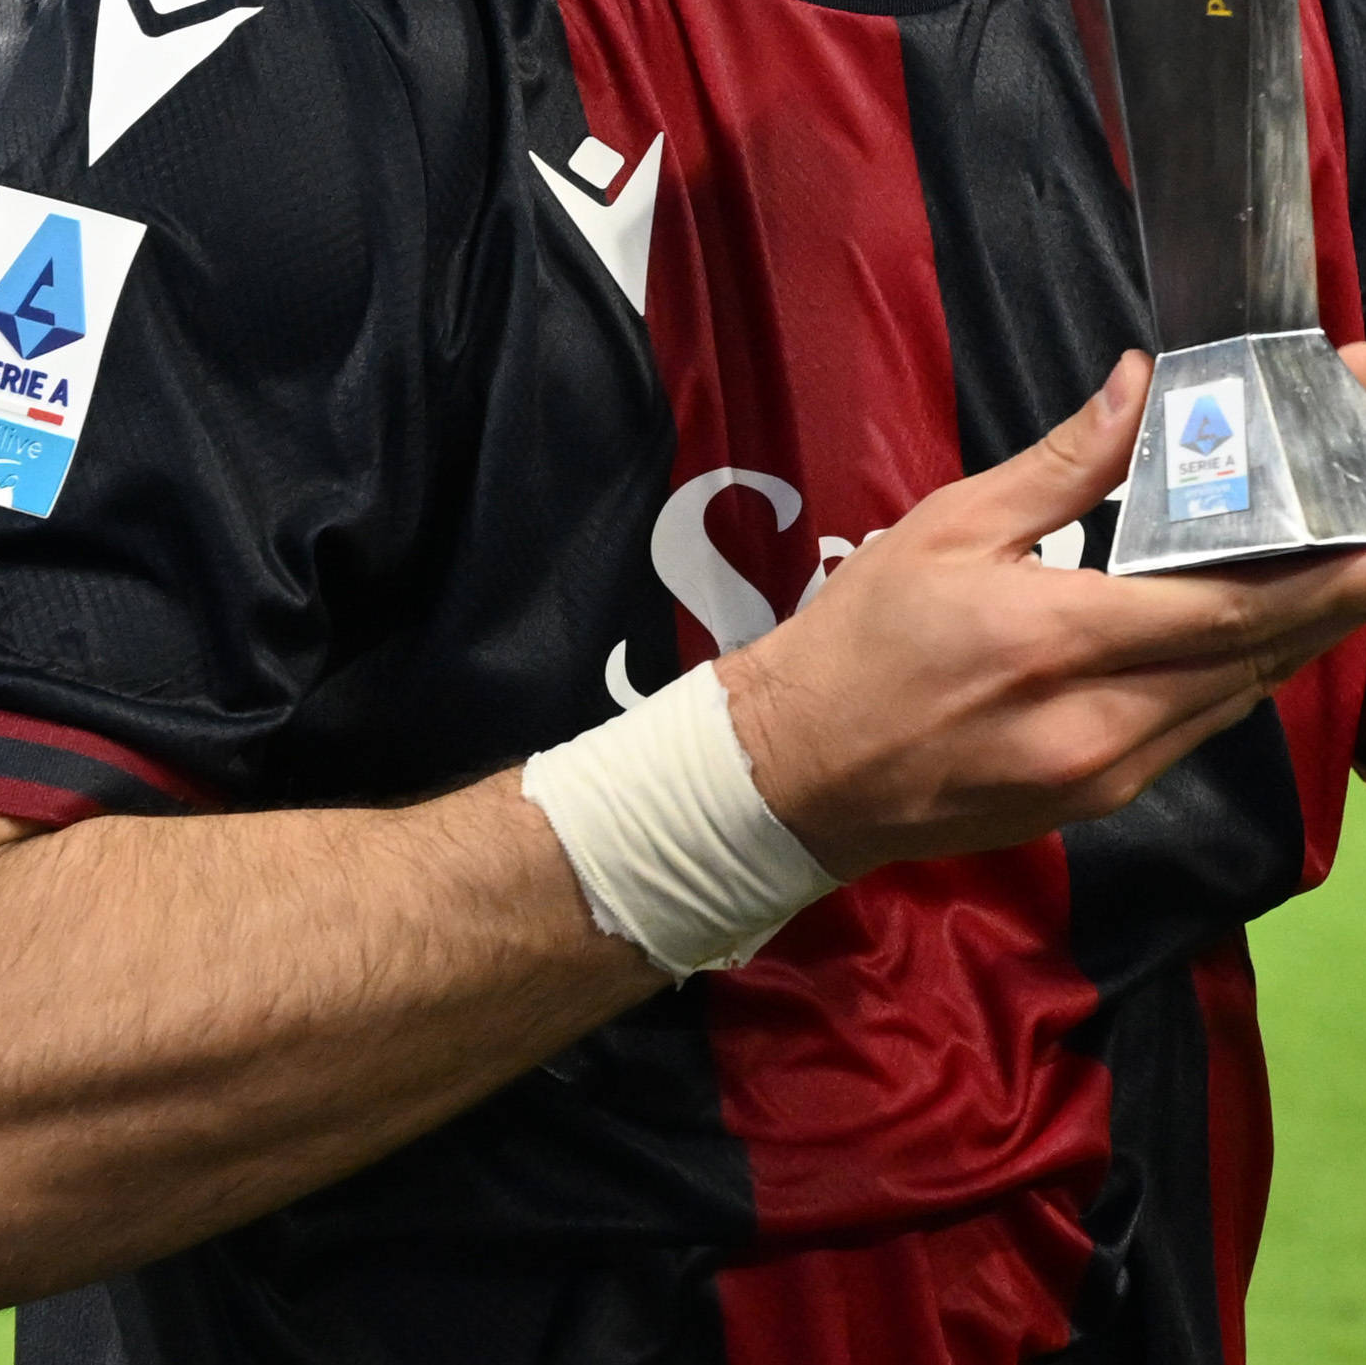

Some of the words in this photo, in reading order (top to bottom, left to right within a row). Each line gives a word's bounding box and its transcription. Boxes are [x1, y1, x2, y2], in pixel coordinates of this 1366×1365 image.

[48, 378, 68, 407] A
[1179, 457, 1220, 475] SERIE
[1225, 455, 1236, 466] A
